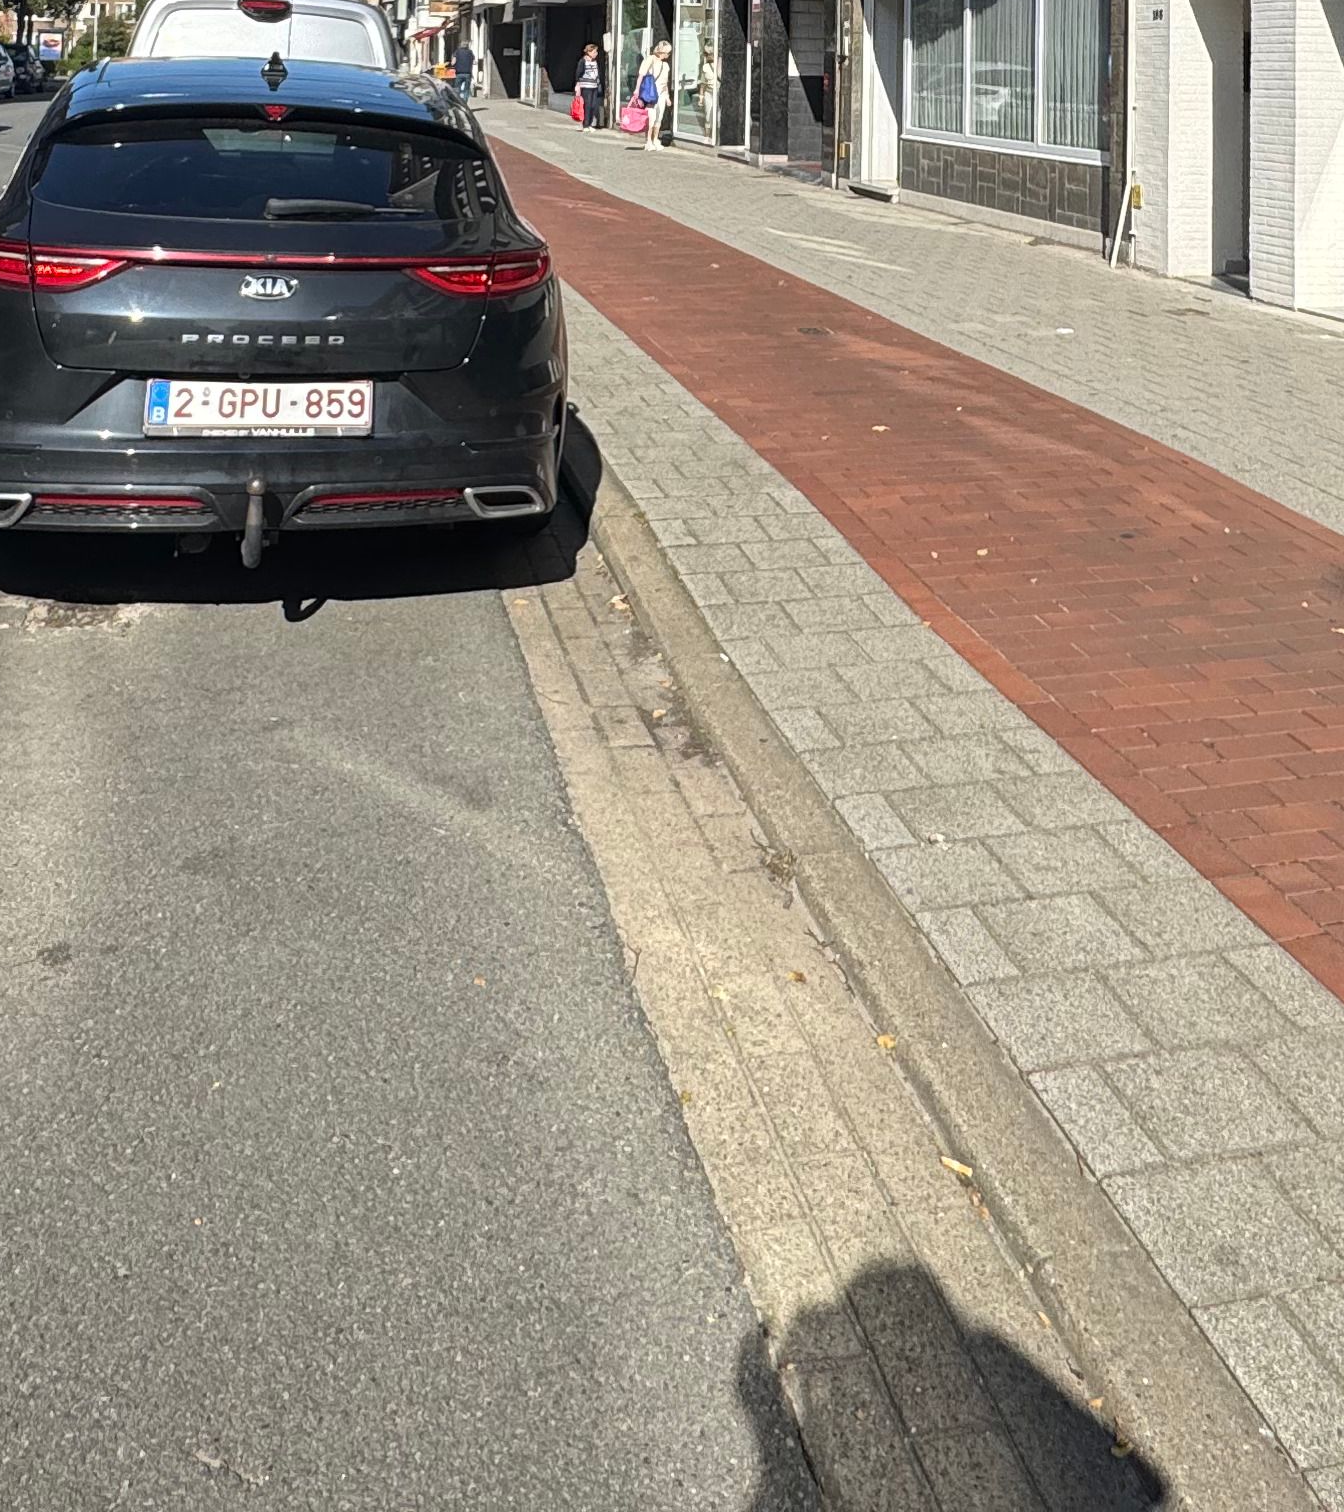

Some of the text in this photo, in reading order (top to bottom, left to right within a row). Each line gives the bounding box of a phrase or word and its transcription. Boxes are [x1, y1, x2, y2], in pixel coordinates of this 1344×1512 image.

[250, 277, 289, 296] KIA
[181, 334, 346, 345] PROCEED
[152, 387, 366, 421] B 2-GPU-859
